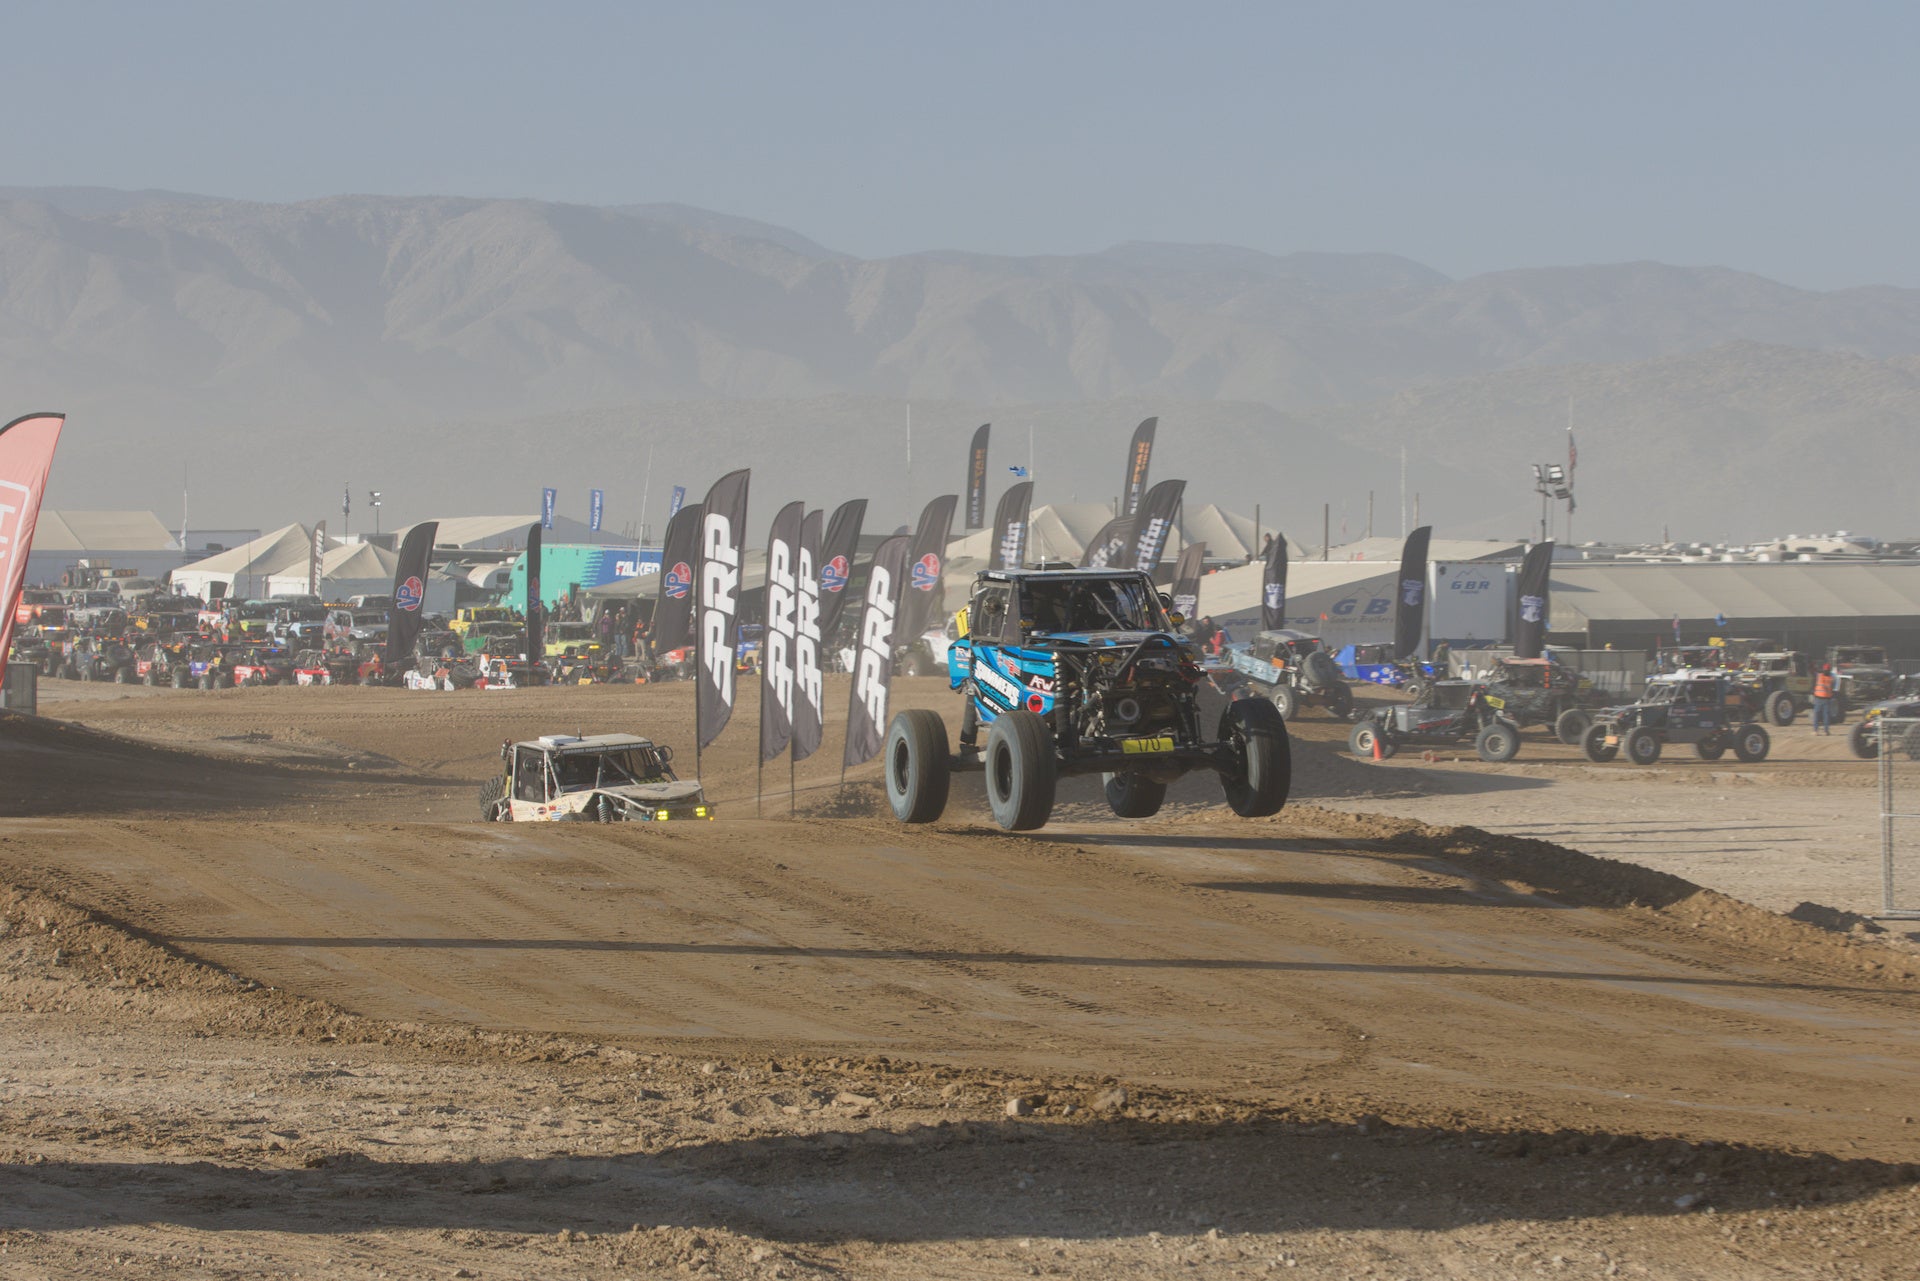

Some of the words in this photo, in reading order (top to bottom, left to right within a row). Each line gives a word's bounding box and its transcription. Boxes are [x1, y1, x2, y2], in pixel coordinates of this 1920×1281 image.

[396, 584, 421, 609] VP
[664, 571, 690, 597] VP
[703, 512, 738, 707] PRP
[821, 564, 848, 590] VP
[912, 561, 937, 588] VP
[767, 538, 795, 726] PRP
[796, 546, 822, 725] PRP
[857, 565, 897, 738] PRP
